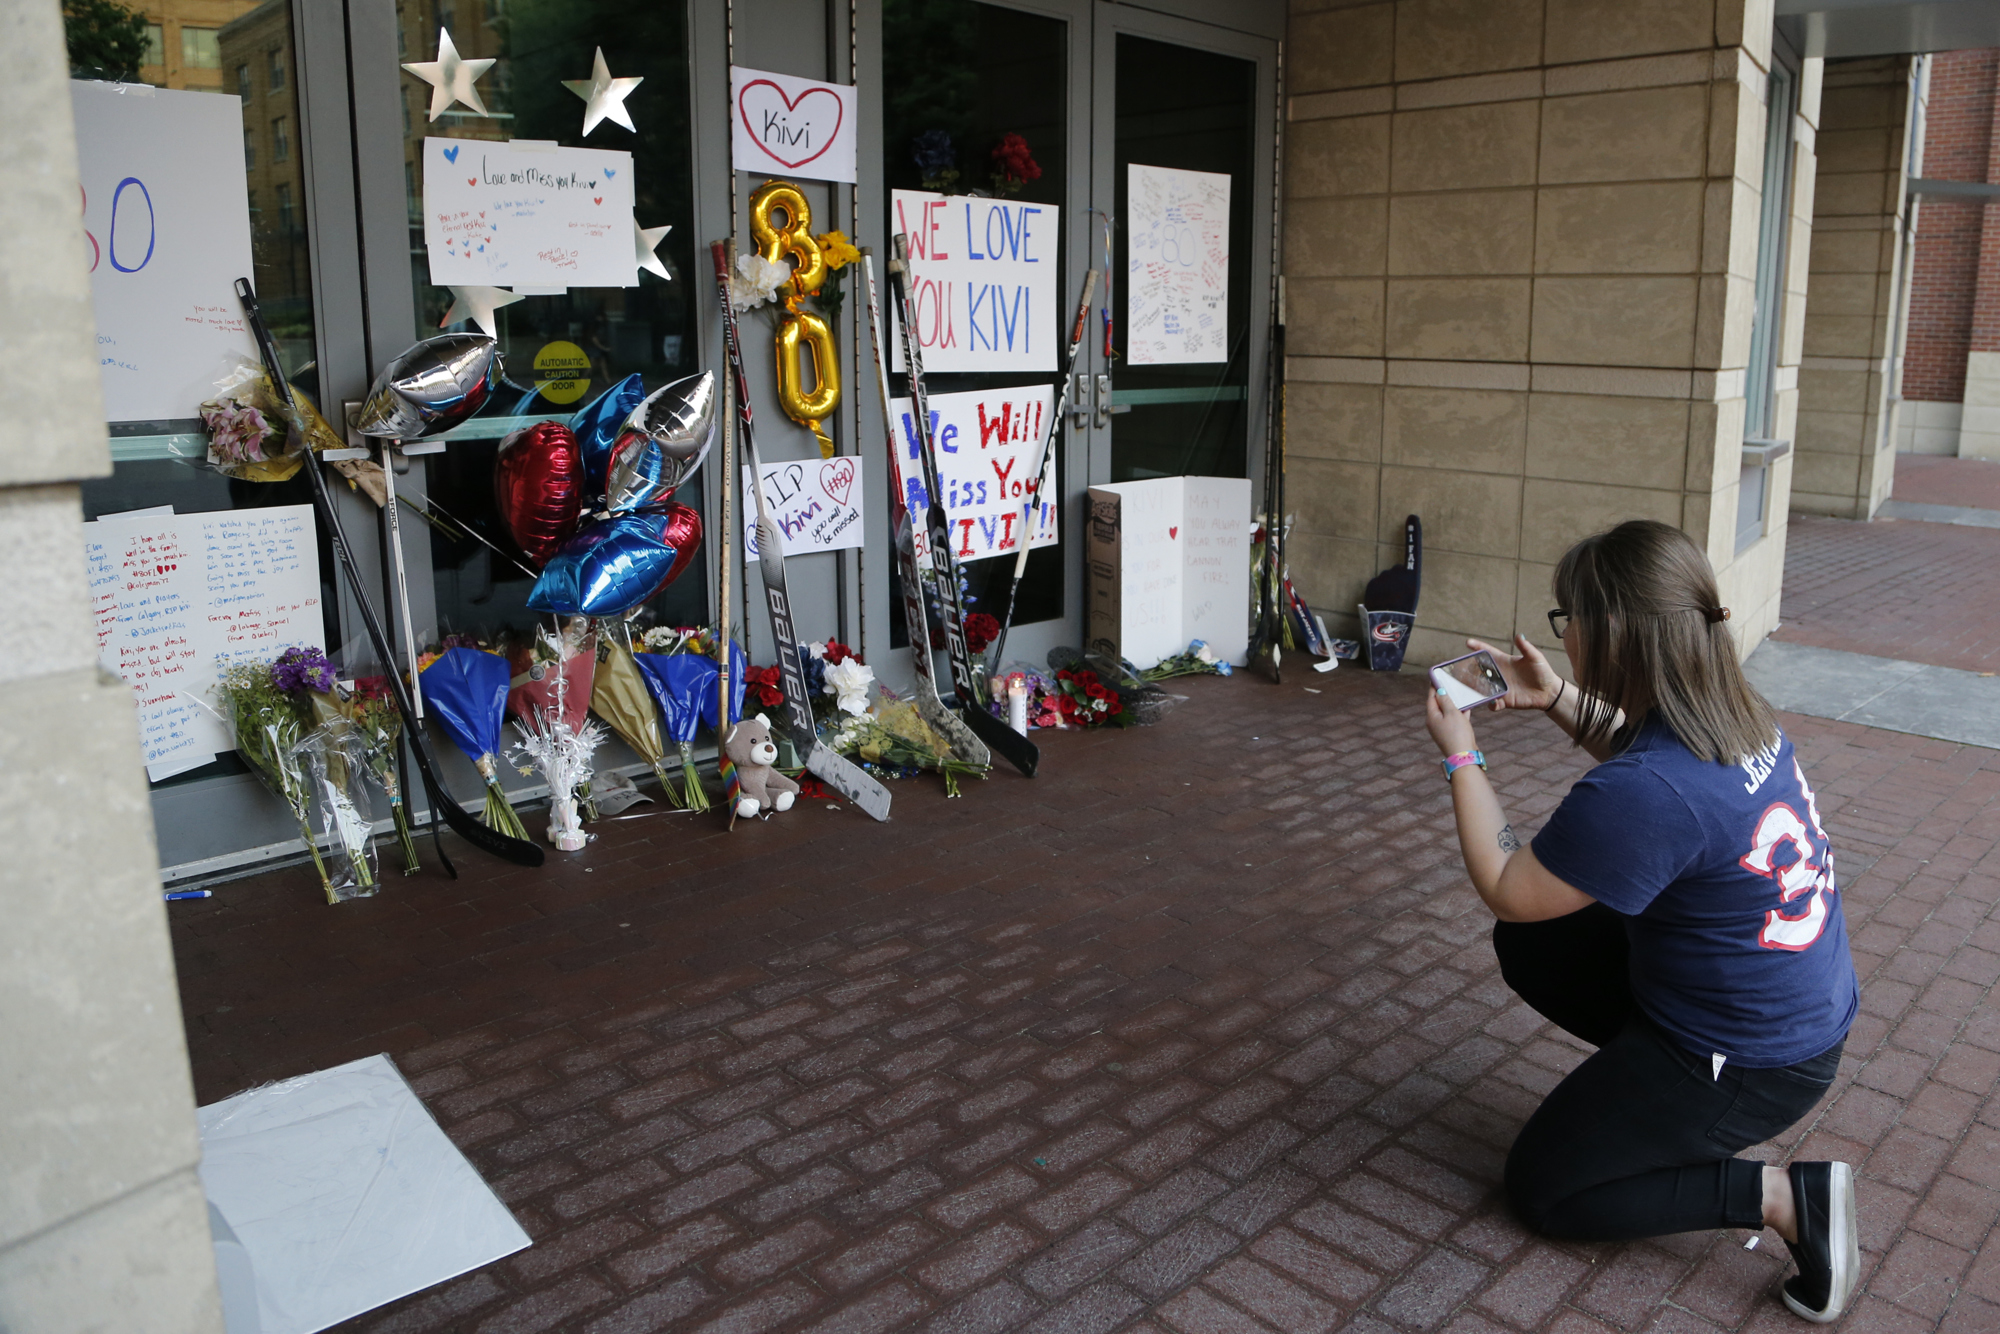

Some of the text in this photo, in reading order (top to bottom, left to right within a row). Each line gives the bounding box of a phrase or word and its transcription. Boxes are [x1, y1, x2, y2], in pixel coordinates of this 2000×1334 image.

[763, 109, 811, 150] Kivi
[483, 155, 507, 186] Love
[510, 170, 525, 185] and
[897, 199, 1042, 263] WE LOVE
[968, 281, 1030, 354] KIVI
[541, 358, 584, 367] AUTOMATIC
[545, 370, 579, 378] CAUTION
[552, 382, 575, 390] DOOR
[900, 408, 959, 460] We
[976, 400, 1043, 449] Will
[827, 468, 851, 493] #80
[992, 456, 1038, 500] You
[1189, 495, 1220, 509] MAY
[777, 496, 822, 541] Kivi
[812, 520, 826, 543] you
[823, 508, 859, 544] be missed
[332, 536, 347, 562] TECH
[1217, 537, 1238, 547] THAT
